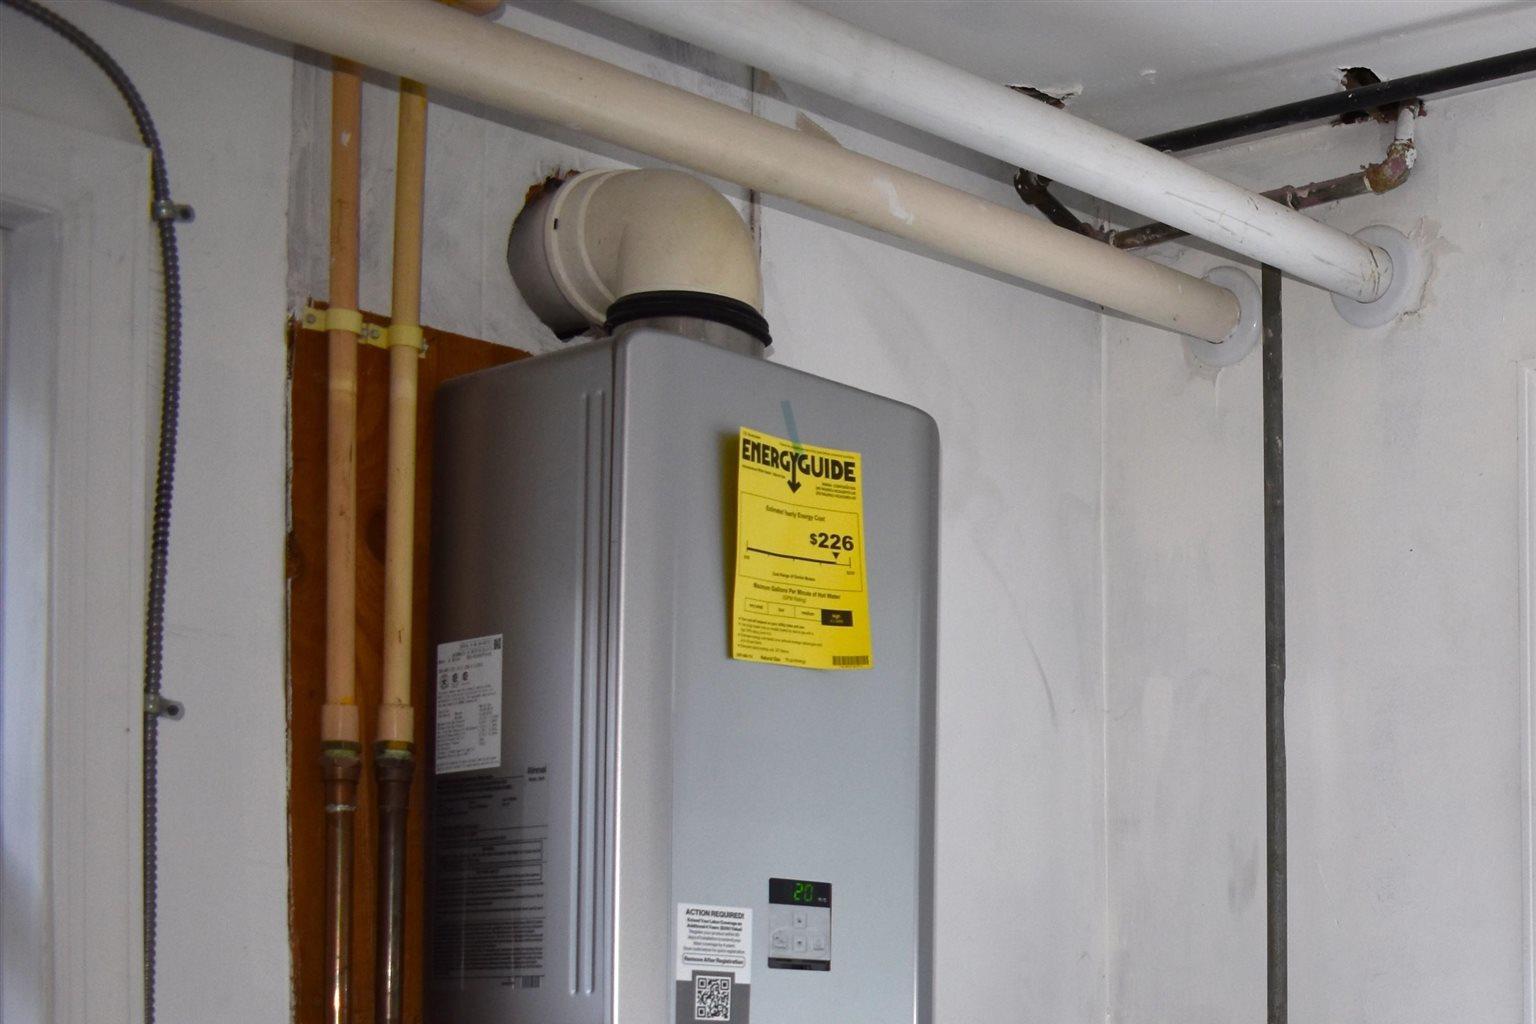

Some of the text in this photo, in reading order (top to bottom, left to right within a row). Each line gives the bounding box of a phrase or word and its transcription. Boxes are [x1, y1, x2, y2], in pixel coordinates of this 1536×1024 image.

[742, 438, 856, 482] ENERGYGUIDE
[810, 532, 855, 551] $226
[711, 911, 744, 919] REQUIRED!
